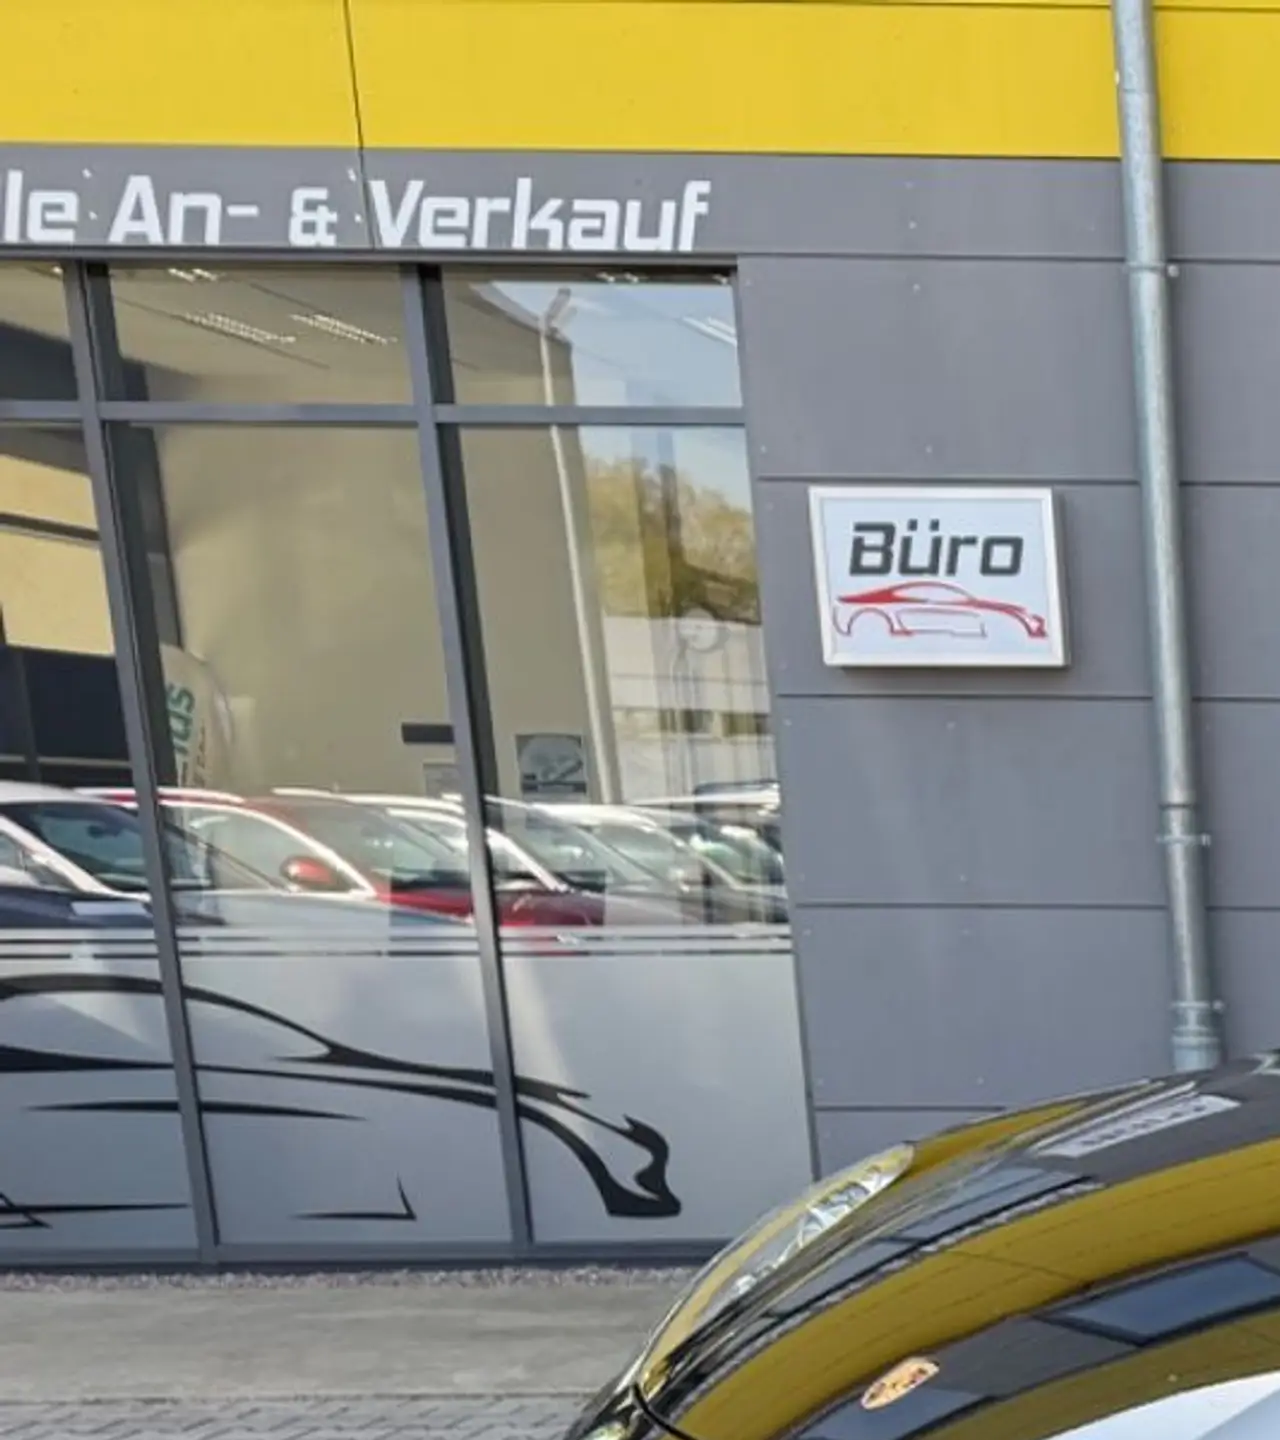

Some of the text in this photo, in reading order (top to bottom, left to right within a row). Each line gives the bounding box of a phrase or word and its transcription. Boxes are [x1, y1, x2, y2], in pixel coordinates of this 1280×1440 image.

[107, 174, 259, 246] An-
[288, 187, 338, 248] &
[367, 177, 711, 252] Verkauf
[849, 518, 1024, 577] Büro
